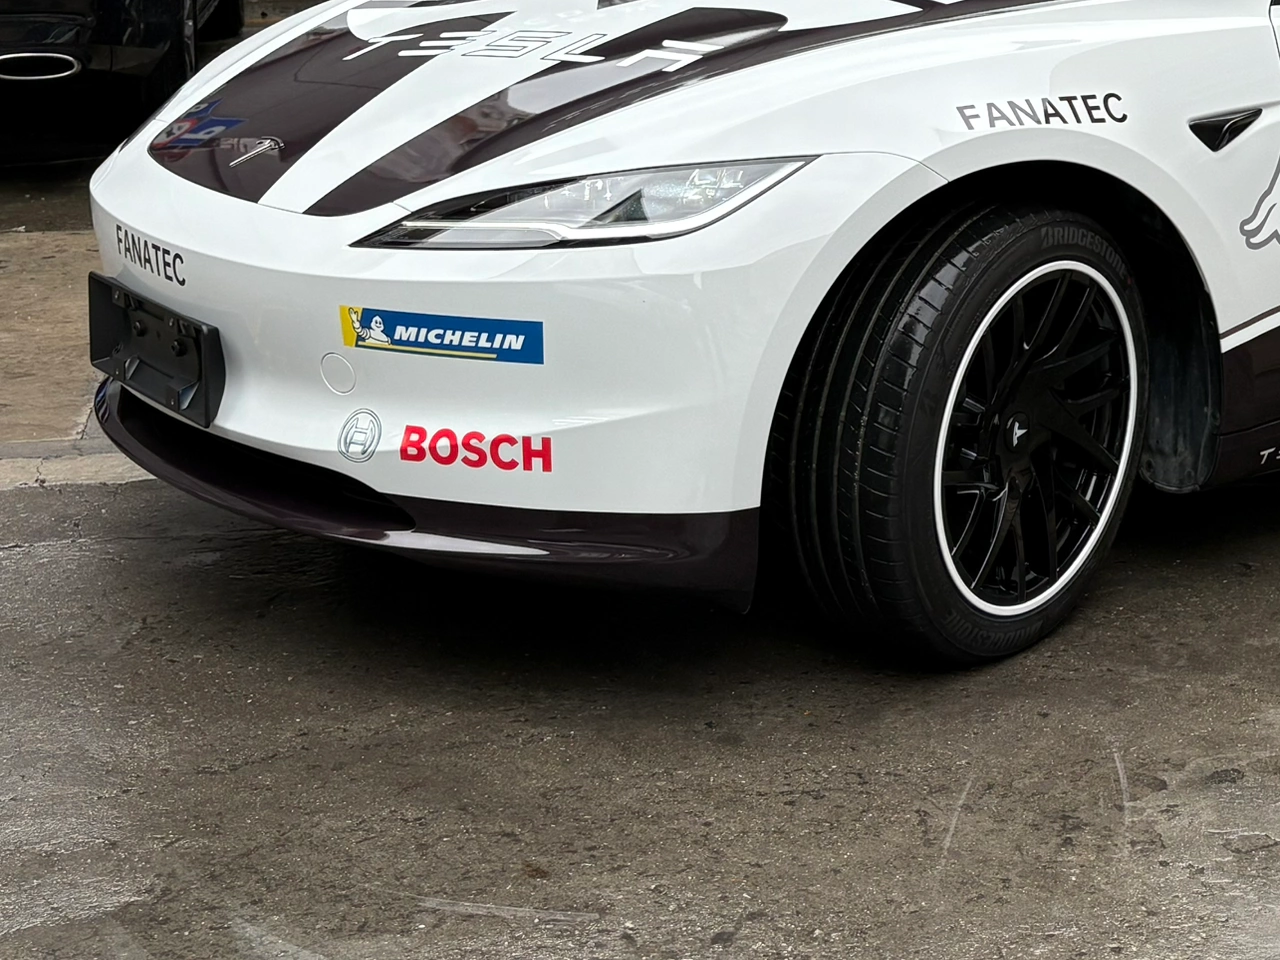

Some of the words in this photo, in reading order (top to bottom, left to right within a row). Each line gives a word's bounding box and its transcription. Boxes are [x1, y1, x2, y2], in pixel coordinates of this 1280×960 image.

[342, 29, 724, 72] TESLA
[956, 92, 1128, 131] FANATEC
[115, 224, 186, 287] FANATEC
[393, 325, 526, 351] MICHELIN
[400, 424, 553, 473] BOSCH
